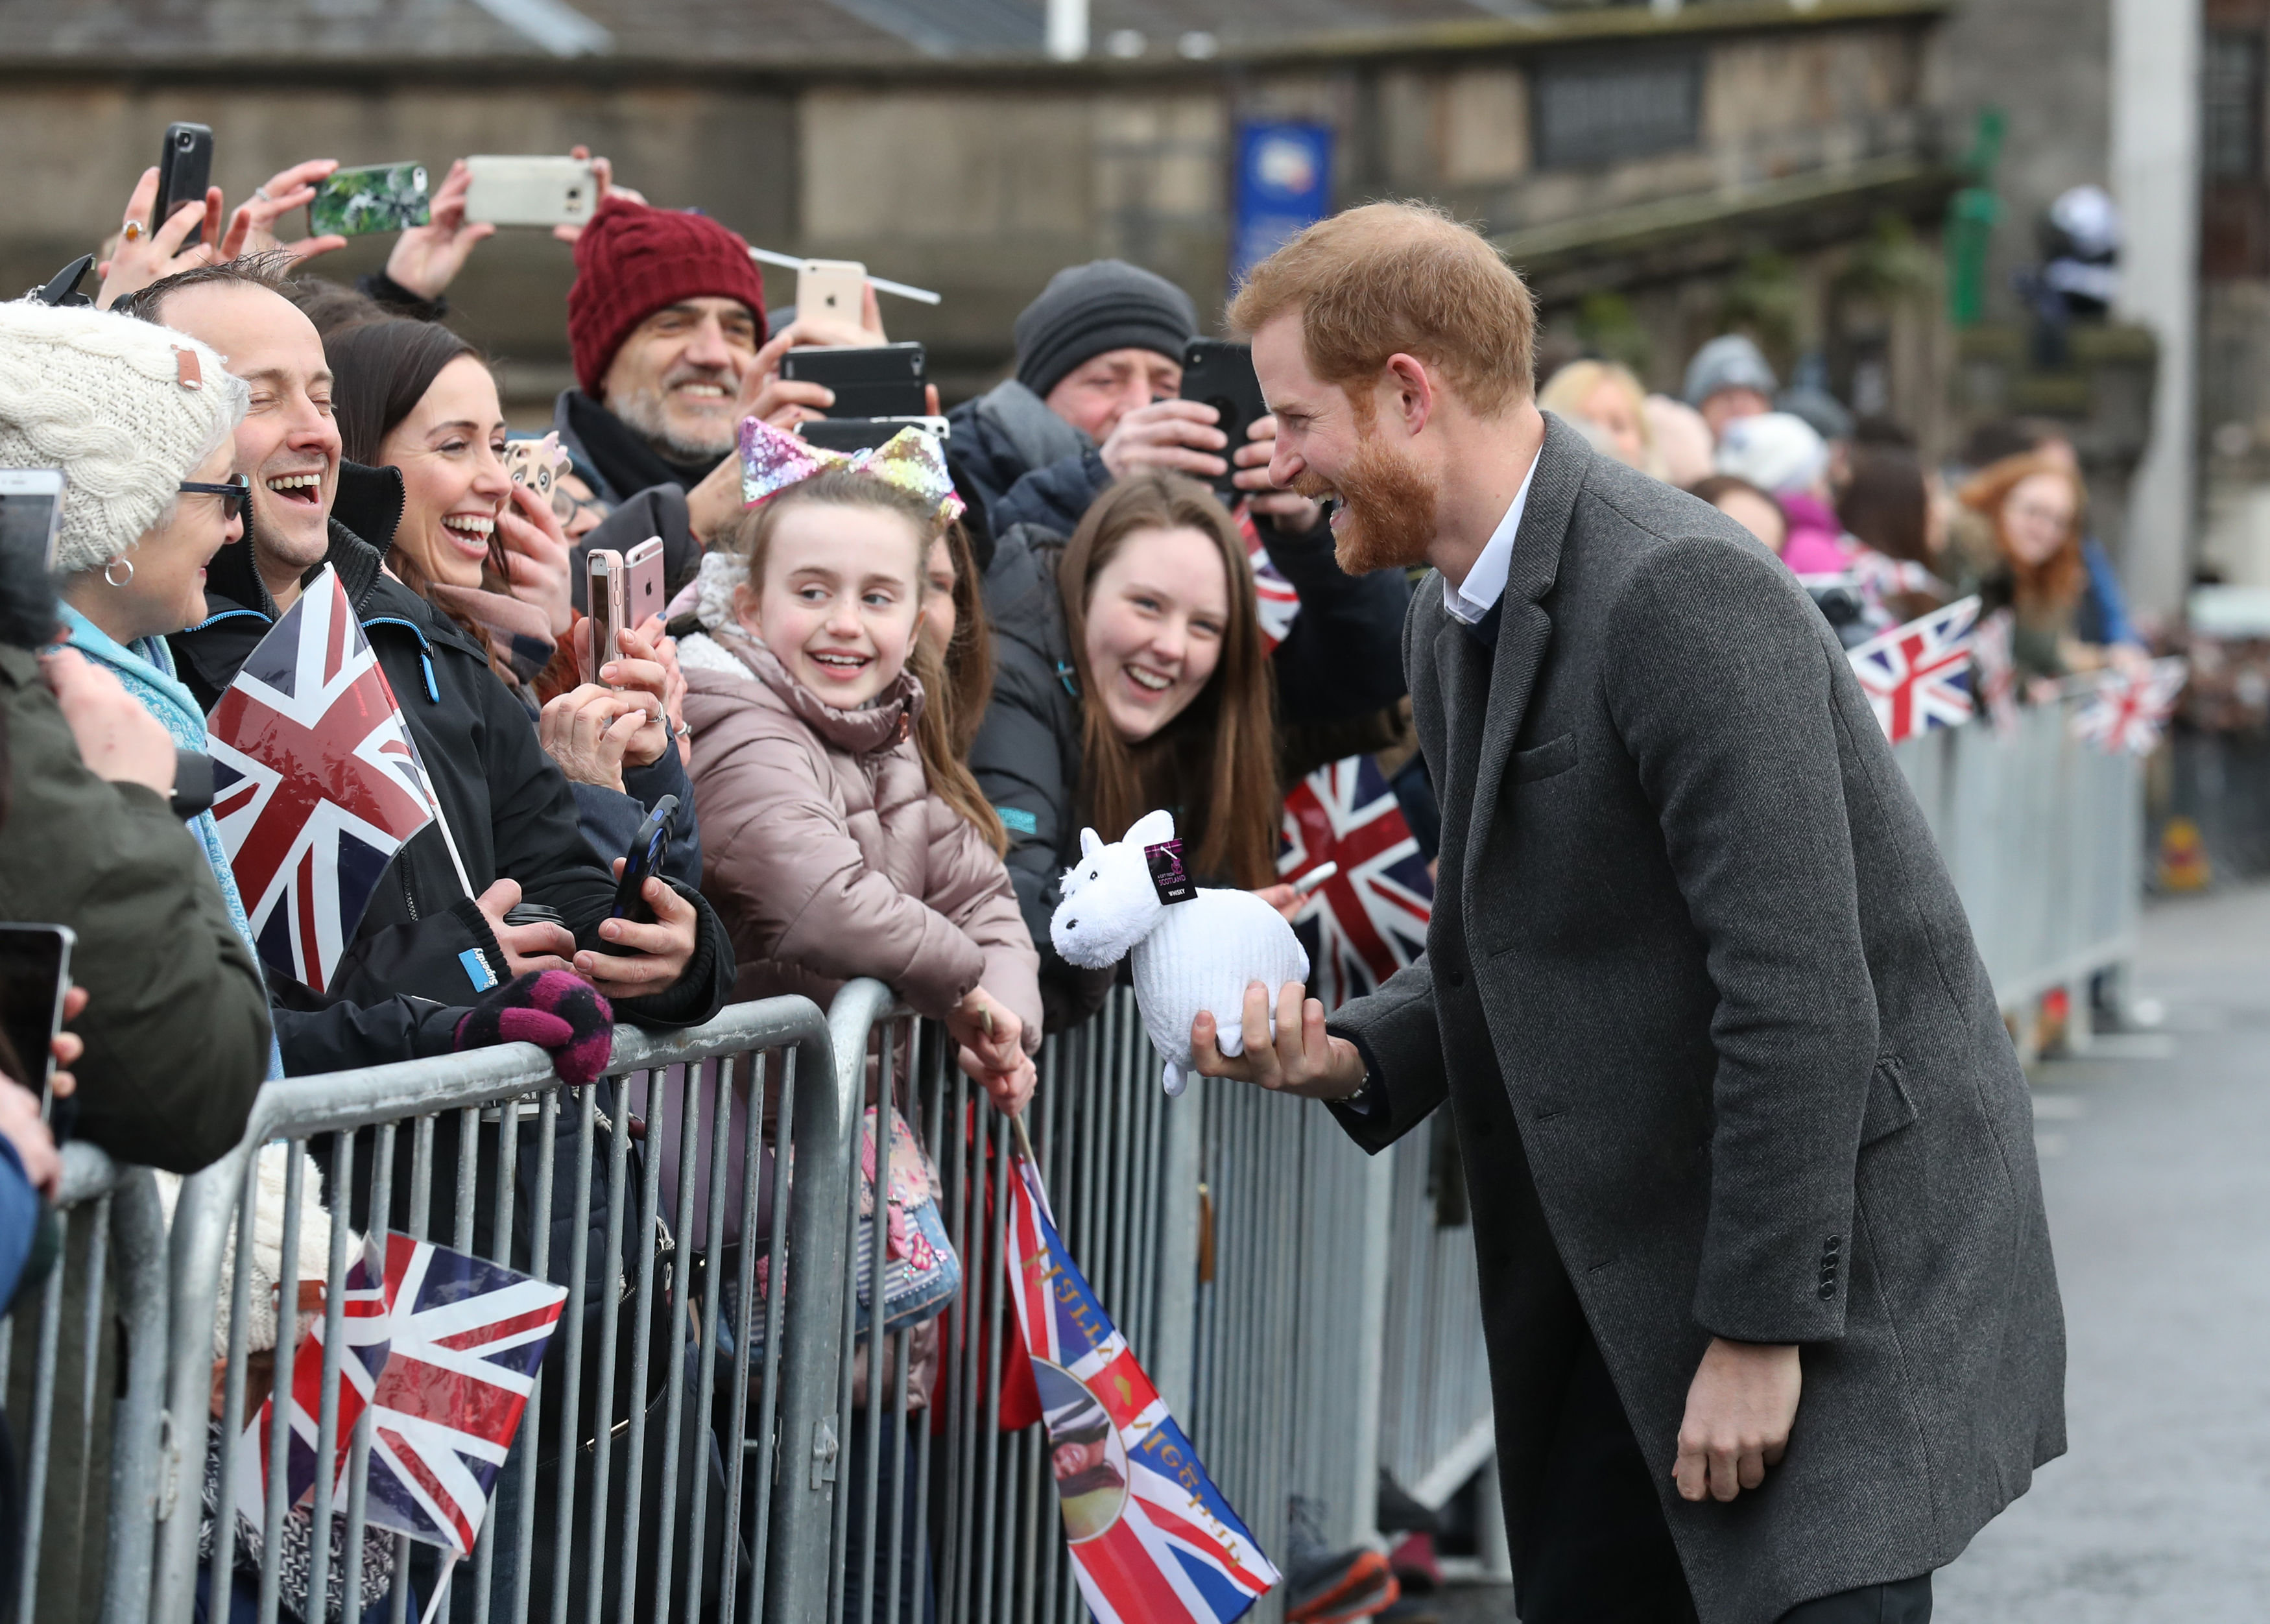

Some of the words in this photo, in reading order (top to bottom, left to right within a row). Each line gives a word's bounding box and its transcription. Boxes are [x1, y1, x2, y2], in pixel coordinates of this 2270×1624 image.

[1158, 875, 1186, 886] SCOTLAND
[1168, 888, 1186, 896] WHISKY
[472, 948, 499, 986] Superdry
